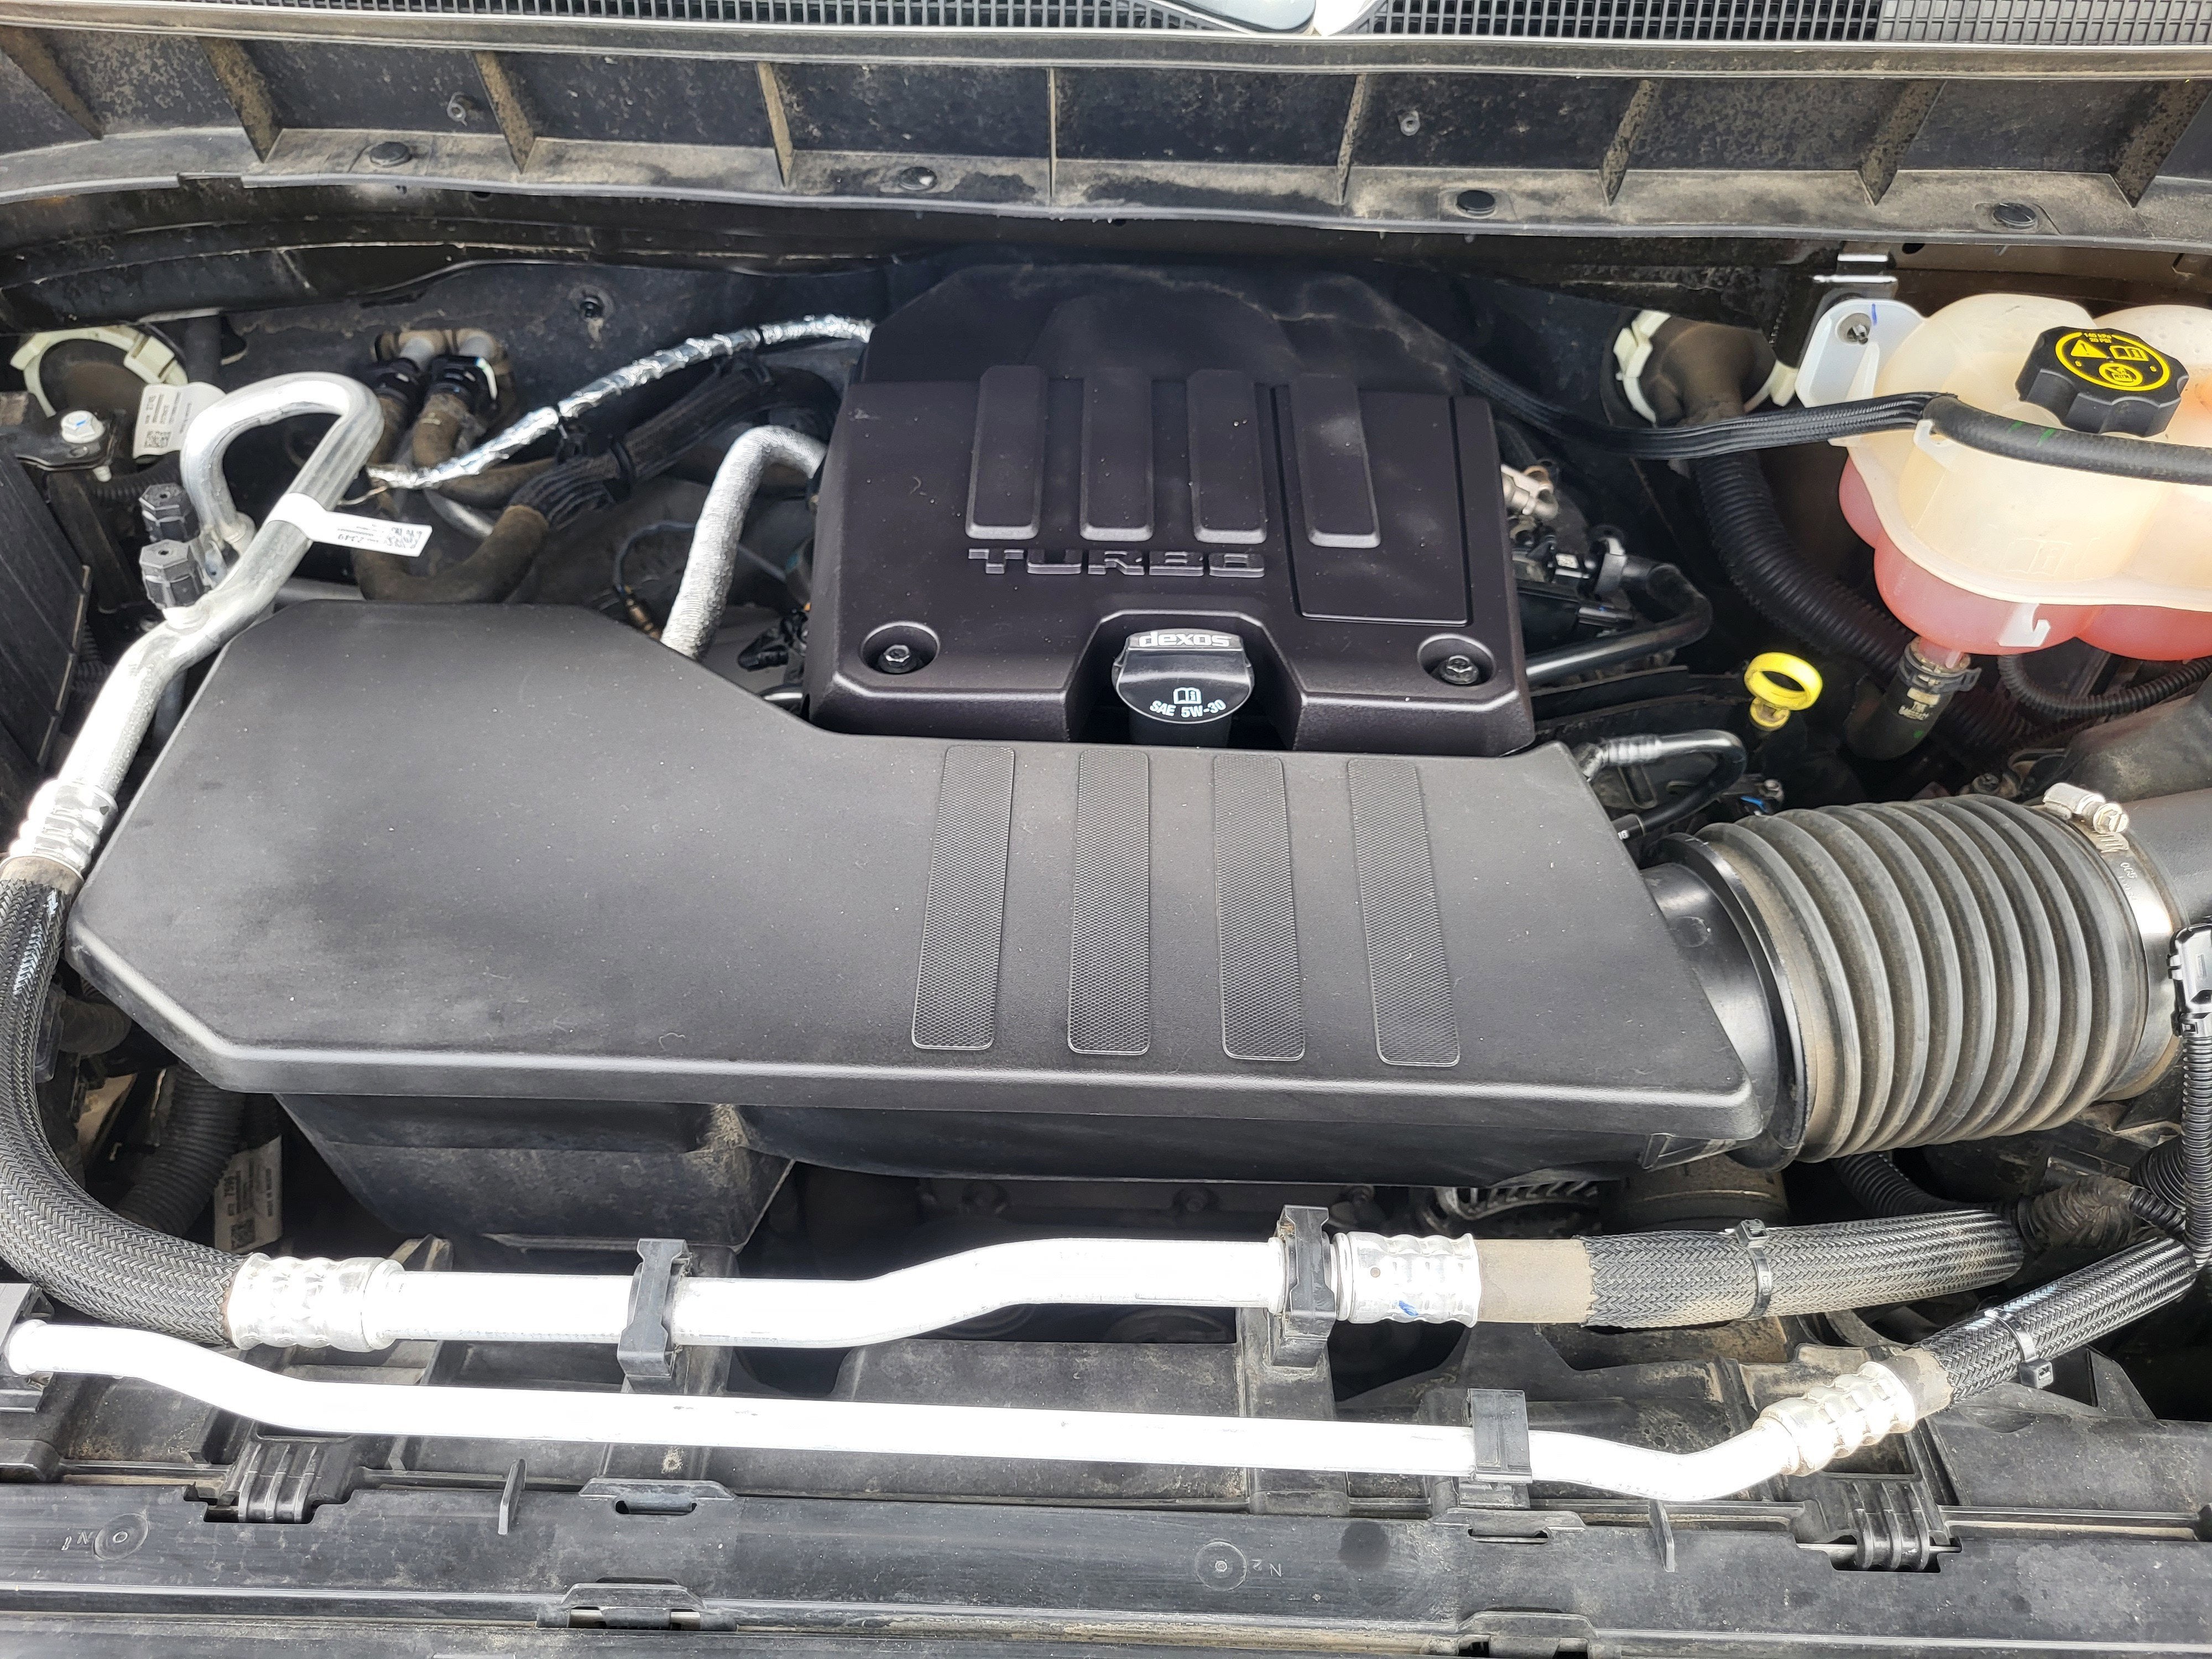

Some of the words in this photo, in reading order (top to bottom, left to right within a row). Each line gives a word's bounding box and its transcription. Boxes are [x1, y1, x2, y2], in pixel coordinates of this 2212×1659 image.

[968, 549, 1265, 578] TURBO
[1139, 631, 1232, 648] dexos
[1149, 700, 1177, 717] SAE
[1181, 699, 1227, 718] 5W-30
